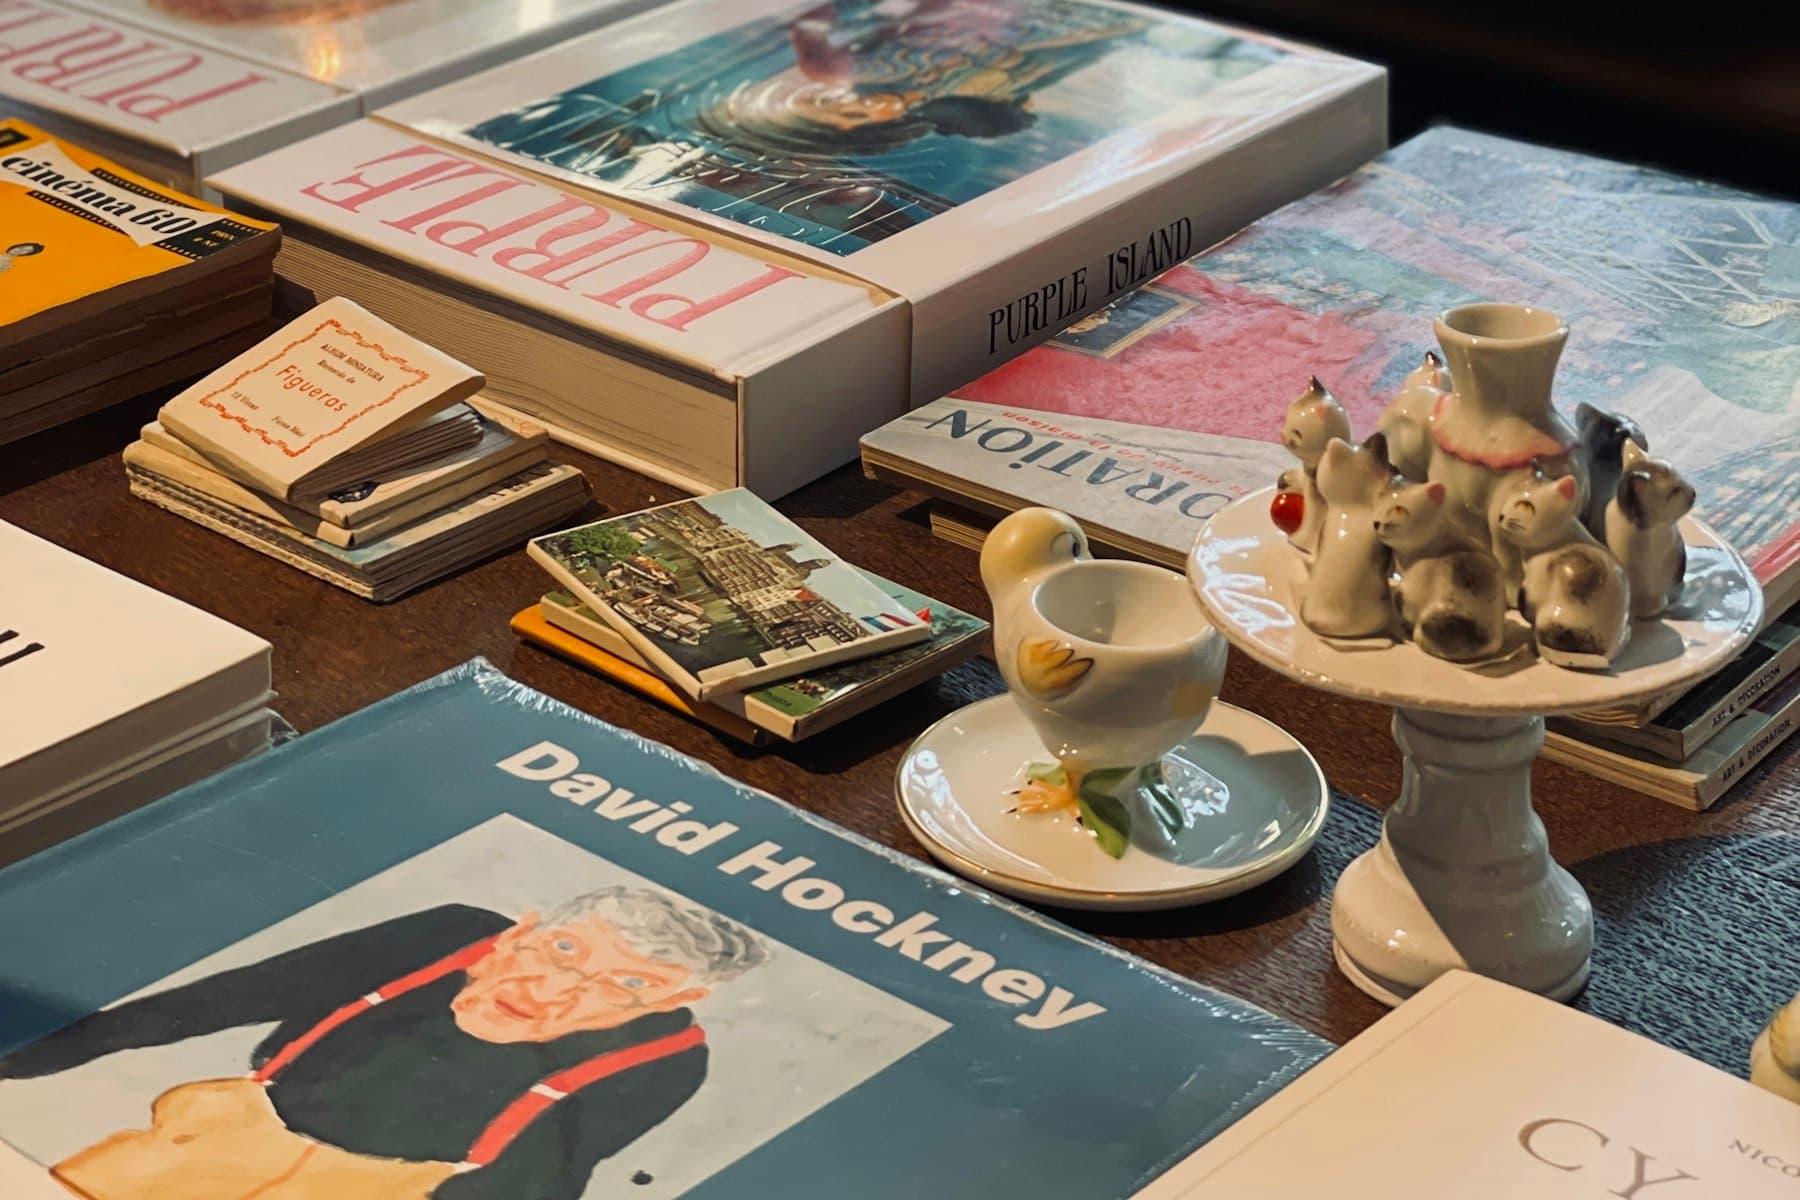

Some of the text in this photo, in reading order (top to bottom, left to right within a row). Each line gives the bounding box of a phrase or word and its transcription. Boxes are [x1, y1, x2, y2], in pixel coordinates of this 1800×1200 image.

[1, 156, 198, 234] cinéma 60
[301, 145, 807, 333] PURPLE
[987, 217, 1192, 356] PURPLE ISLAND
[275, 364, 348, 413] Figueras
[1001, 411, 1084, 441] maison
[497, 741, 1107, 1031] David Hockney
[1518, 1117, 1700, 1200] CY
[1728, 1138, 1800, 1178] NICO
